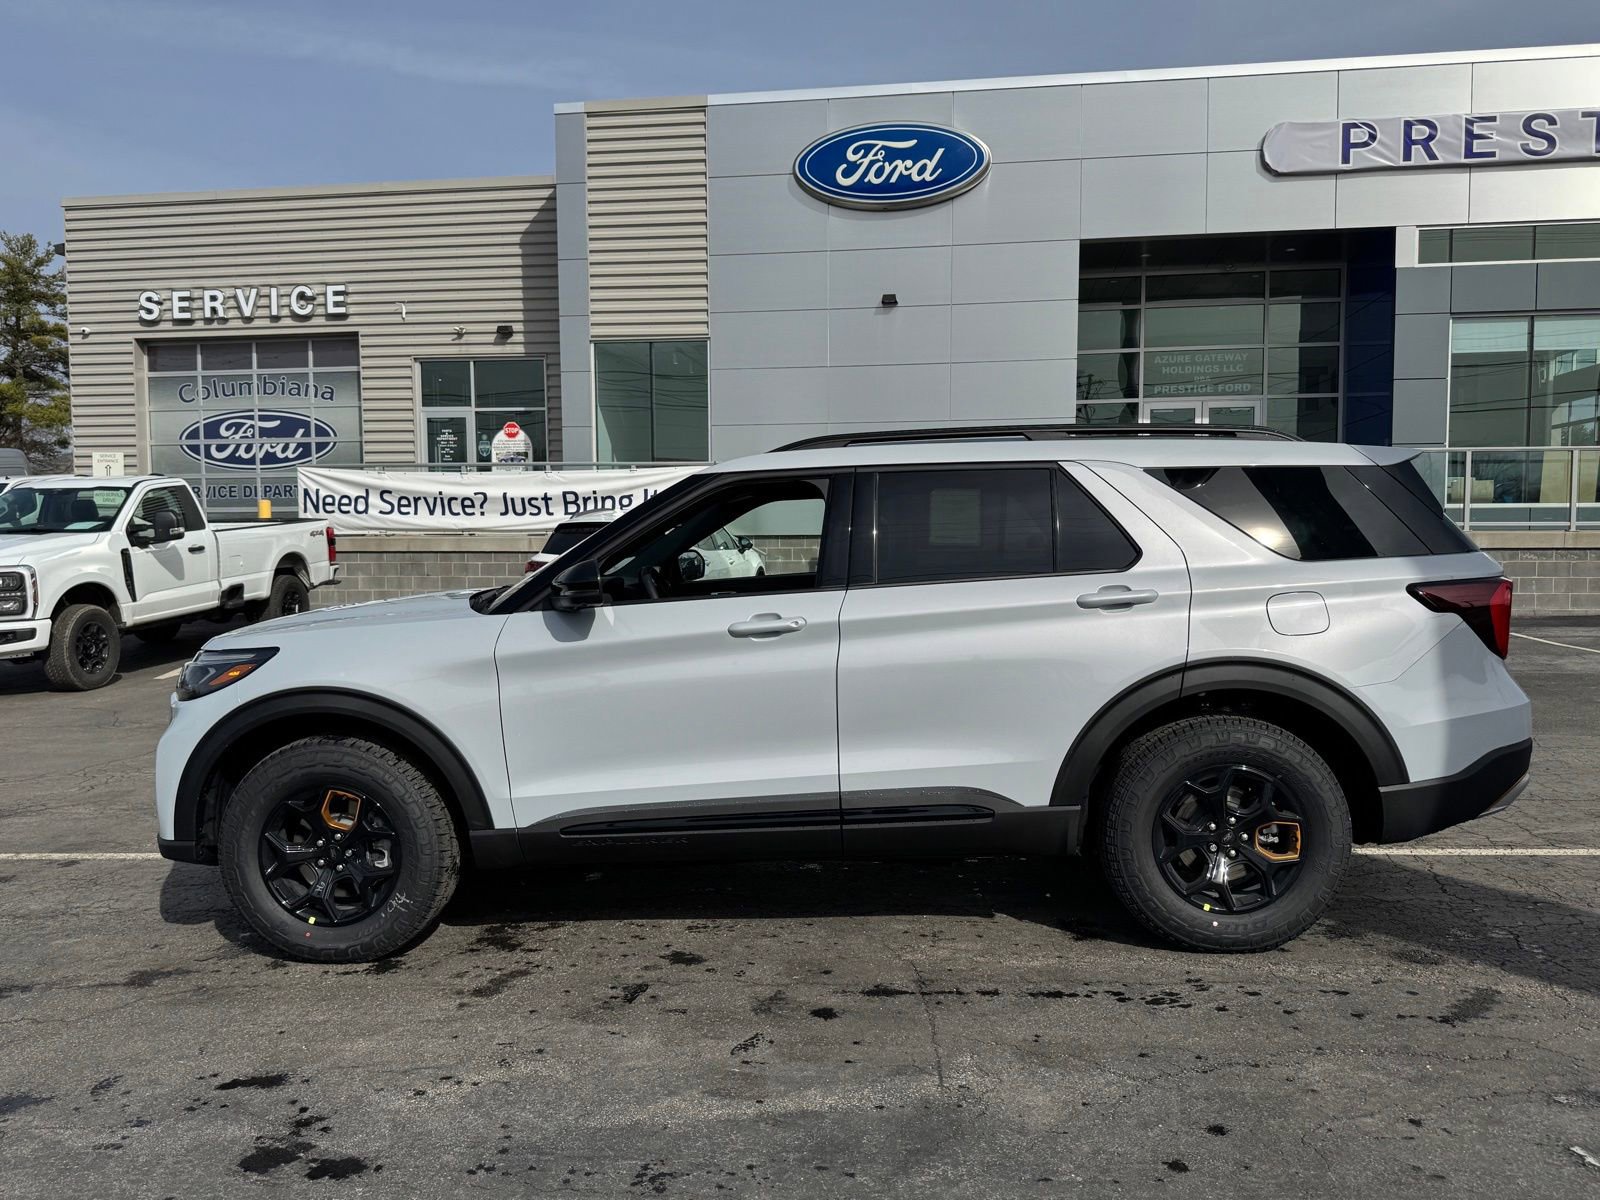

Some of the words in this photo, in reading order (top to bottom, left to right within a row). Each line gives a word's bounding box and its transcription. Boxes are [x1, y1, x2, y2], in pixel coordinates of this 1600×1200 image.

[835, 139, 945, 187] Ford
[138, 284, 348, 322] SERVICE
[1154, 354, 1192, 364] AZURE
[1195, 352, 1249, 362] GATEWAY
[1162, 364, 1220, 375] HOLDINGS
[1223, 364, 1244, 372] LLC
[178, 375, 336, 404] Columbiana
[1154, 384, 1214, 394] PRESTIGE
[1218, 383, 1251, 392] FORD
[210, 418, 305, 460] Ford
[303, 488, 370, 514] Need
[378, 489, 488, 517] Service?
[500, 492, 554, 517] Just
[562, 490, 634, 516] Bring
